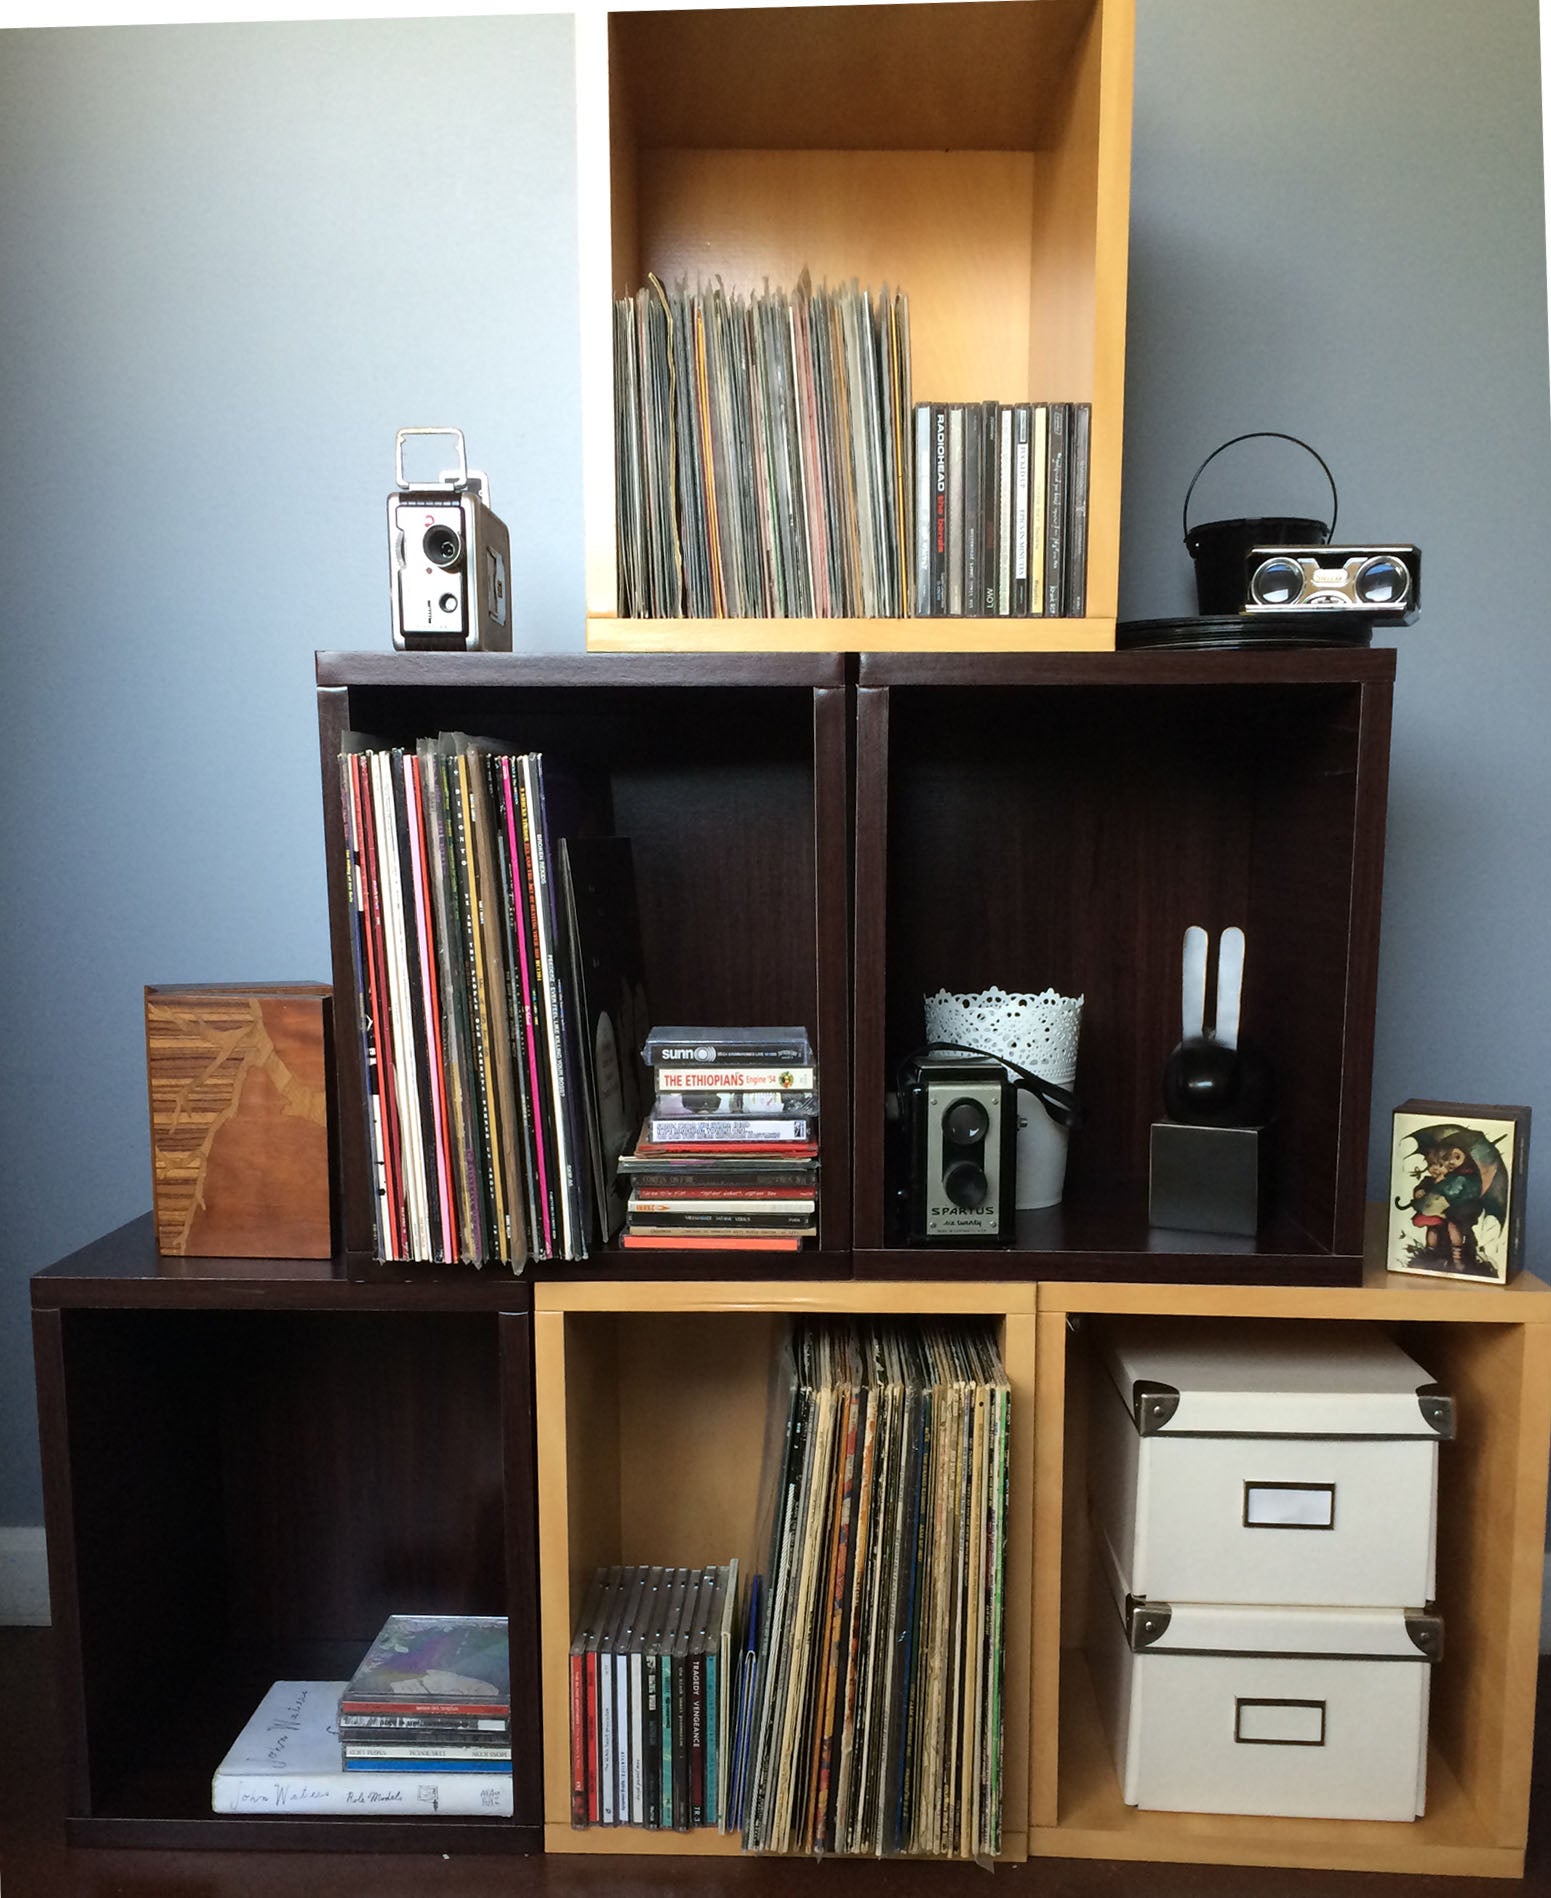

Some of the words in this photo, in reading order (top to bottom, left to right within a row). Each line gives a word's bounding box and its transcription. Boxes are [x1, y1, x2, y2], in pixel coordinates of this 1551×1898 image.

[937, 414, 945, 492] RADIOHEAD
[986, 588, 994, 609] LOW
[536, 834, 544, 860] BROKEN
[554, 1035, 562, 1059] KILLING
[663, 1074, 682, 1087] THE
[685, 1074, 745, 1087] ETHIOPIANS
[746, 1075, 767, 1085] Engine
[931, 1206, 994, 1216] SPARTUS
[956, 1219, 982, 1227] twenty
[230, 1780, 269, 1810] John
[346, 1791, 366, 1804] Role
[367, 1790, 403, 1803] Models
[693, 1806, 700, 1816] TR
